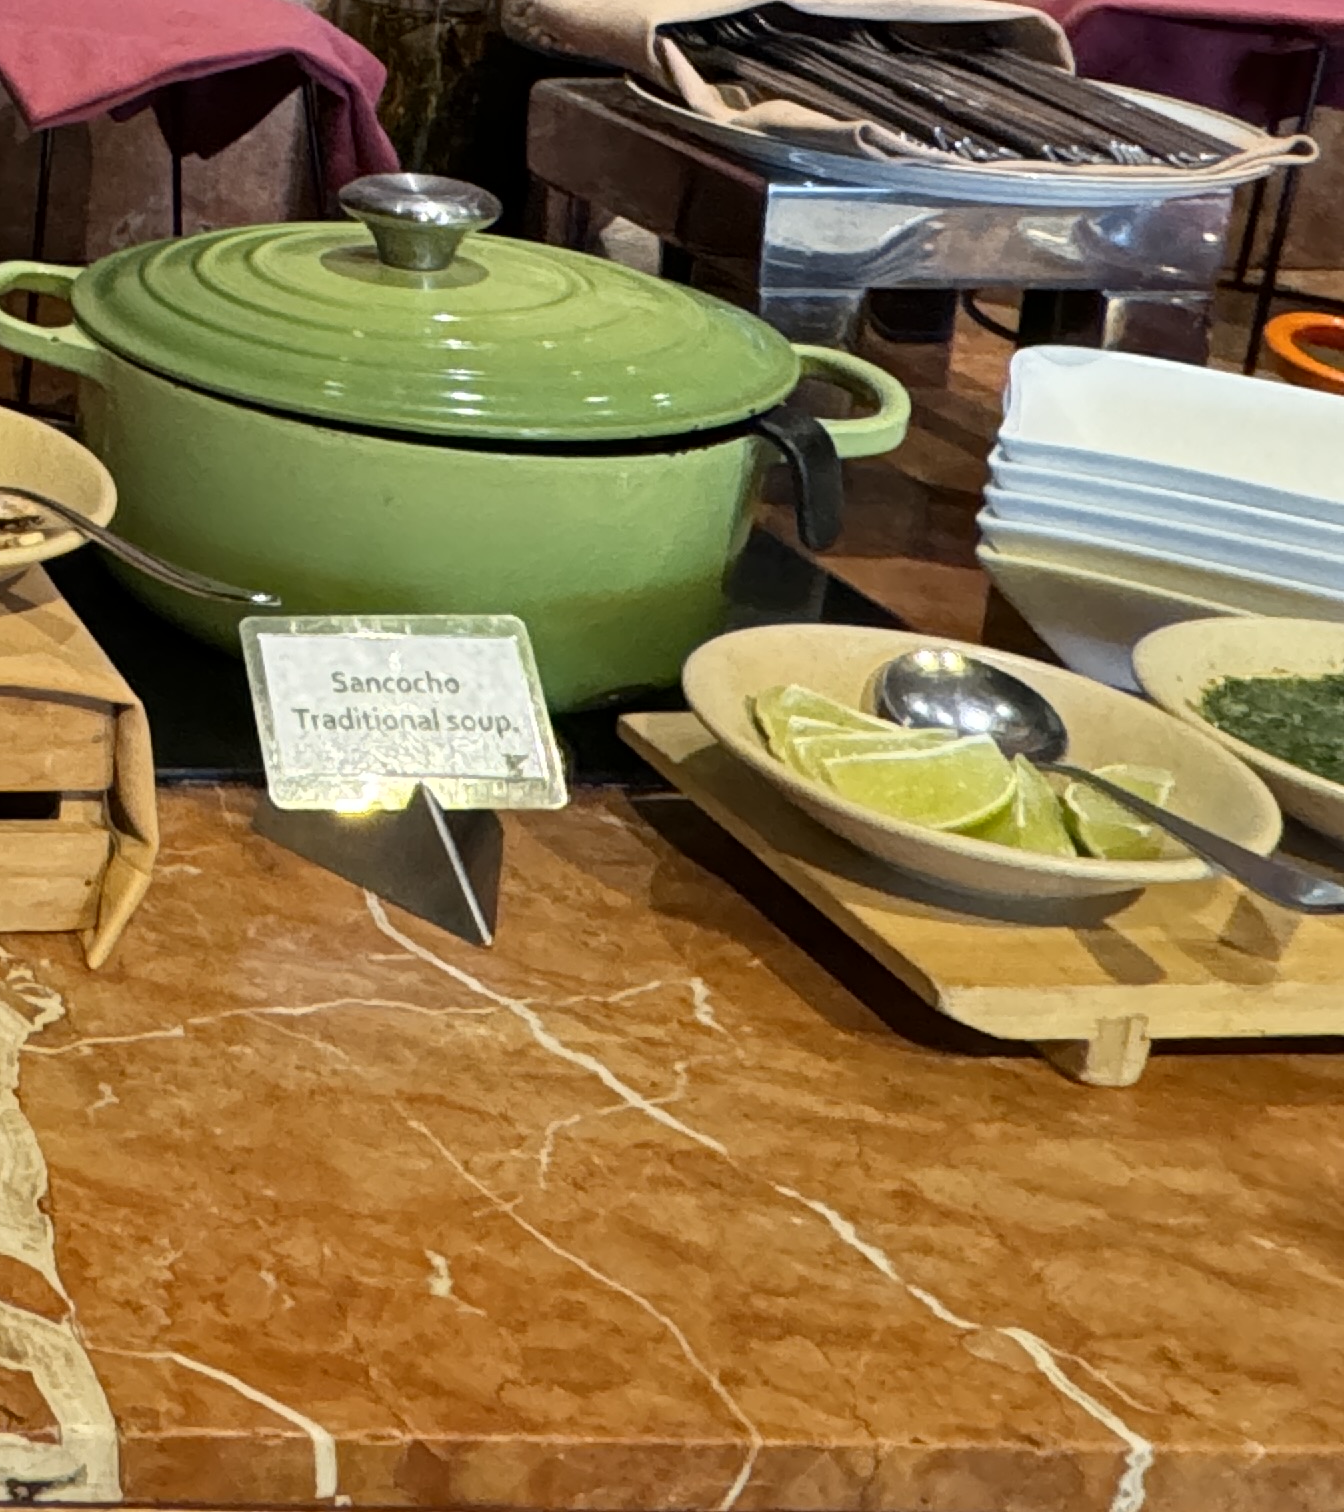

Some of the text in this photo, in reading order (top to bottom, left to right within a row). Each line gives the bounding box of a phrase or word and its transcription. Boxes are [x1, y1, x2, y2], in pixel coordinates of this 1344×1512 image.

[331, 671, 461, 694] Sancocho
[291, 706, 520, 738] Traditional soup.
